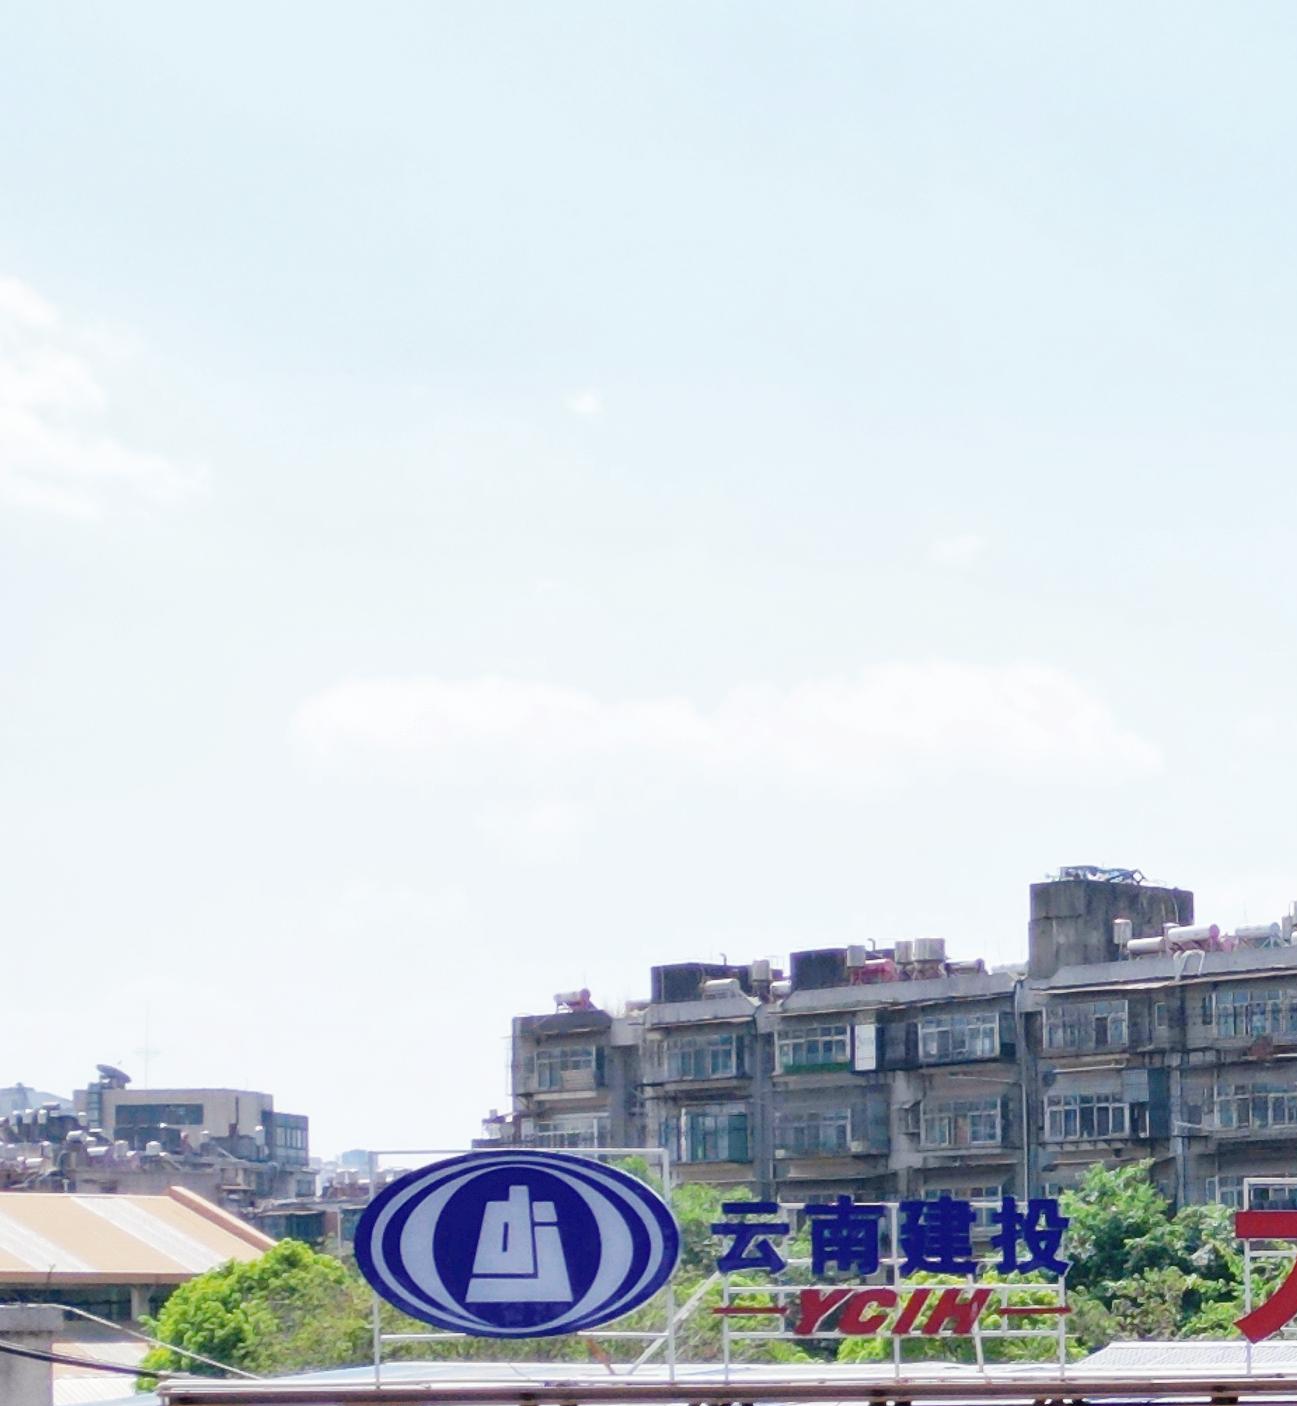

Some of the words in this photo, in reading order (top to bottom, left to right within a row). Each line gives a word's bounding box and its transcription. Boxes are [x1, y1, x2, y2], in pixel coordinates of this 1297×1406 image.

[711, 1194, 1071, 1277] 云南建投
[793, 1287, 993, 1336] YCIH
